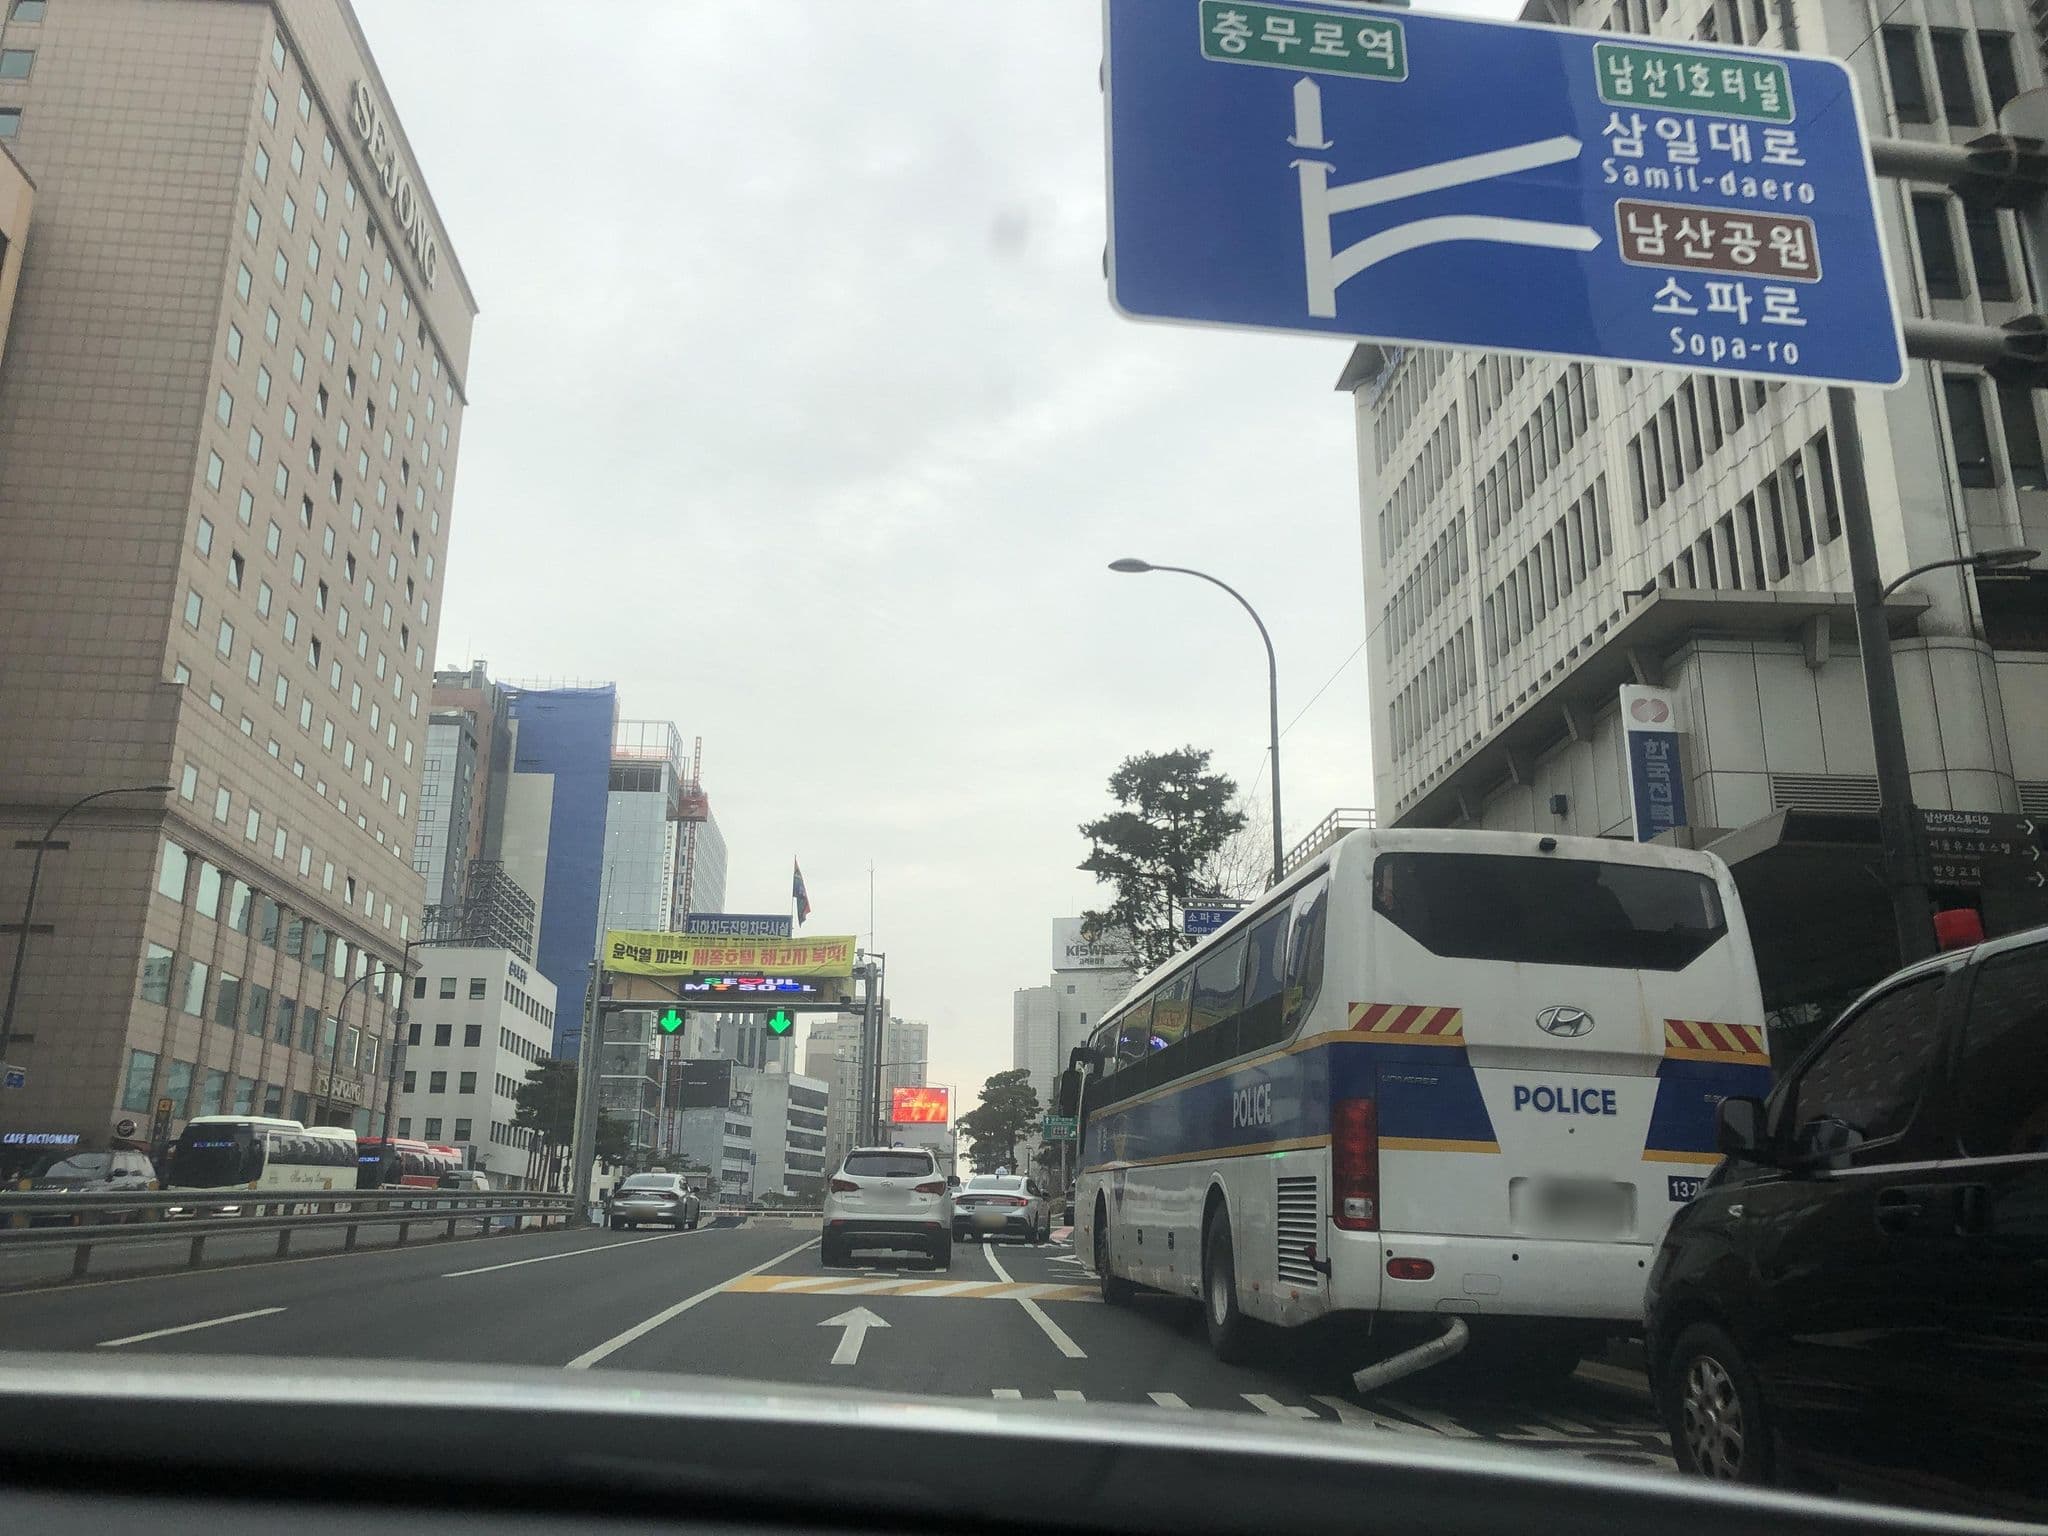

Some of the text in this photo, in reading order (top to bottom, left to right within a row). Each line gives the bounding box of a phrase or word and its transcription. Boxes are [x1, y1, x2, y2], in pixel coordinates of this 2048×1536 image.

[1212, 10, 1395, 70] 충무로역
[1607, 54, 1781, 112] 남산1호터널
[1601, 112, 1806, 167] 삼일대로
[354, 79, 437, 292] SEJONG
[1602, 158, 1815, 204] Samil-daero
[1627, 212, 1809, 270] 남산공원
[1652, 276, 1807, 326] 소파로
[1670, 326, 1799, 365] Sopa-ro
[1188, 912, 1222, 924] 소파로
[656, 948, 688, 965] 파면!
[692, 948, 755, 966] 세종호텔
[760, 947, 808, 966] 해고자
[1233, 1083, 1271, 1128] POLICE
[1514, 1086, 1617, 1114] POLICE
[3, 1133, 80, 1144] CAFE DICTIONARY
